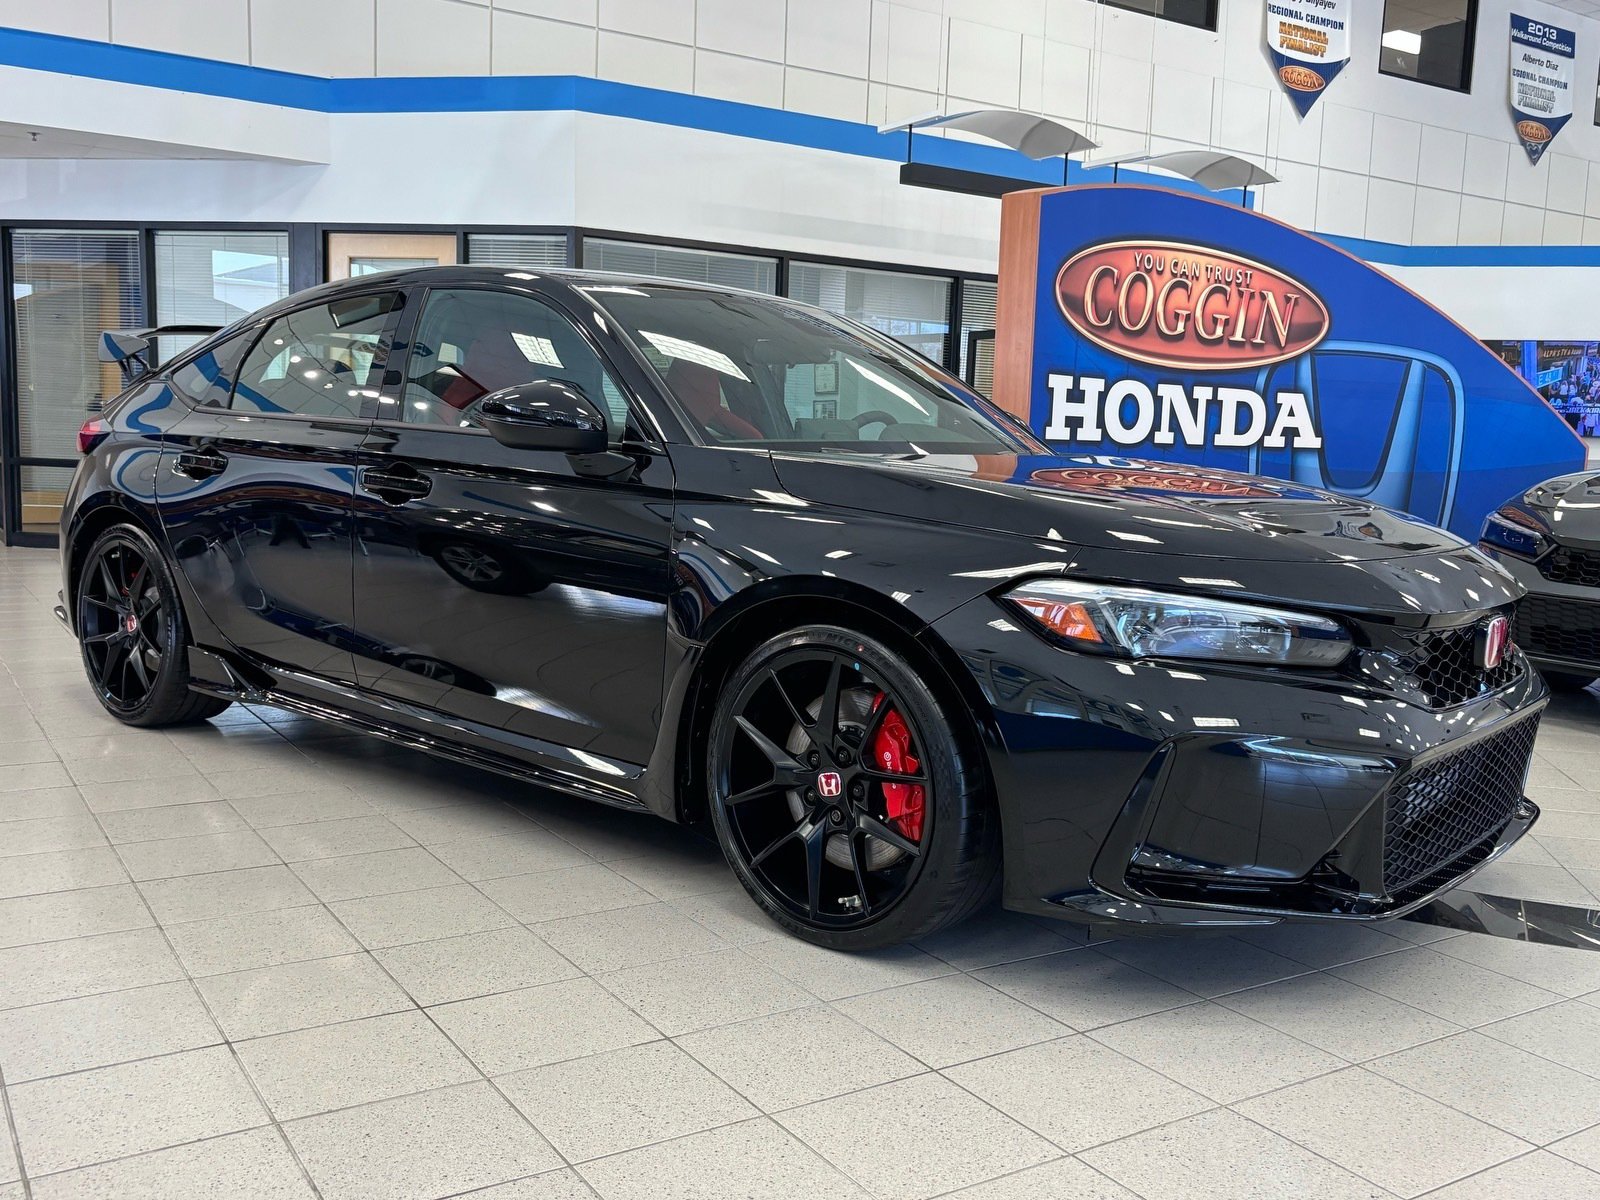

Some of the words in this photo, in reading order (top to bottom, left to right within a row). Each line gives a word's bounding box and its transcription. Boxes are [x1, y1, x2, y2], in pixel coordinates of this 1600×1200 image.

[1267, 3, 1304, 21] REGIONAL
[1305, 13, 1344, 31] CHAMPION
[1279, 21, 1328, 45] NATIONAL
[1511, 28, 1541, 44] Walkaround
[1542, 37, 1572, 53] Competition
[1527, 22, 1557, 40] 2013
[1279, 35, 1327, 58] FINALIST
[1522, 53, 1545, 67] Alberto
[1545, 59, 1559, 71] Diaz
[1282, 70, 1319, 89] COGGIN
[1512, 68, 1537, 82] EGIONAL
[1538, 76, 1568, 90] CHAMPION
[1518, 82, 1555, 102] NATIONAL
[1518, 95, 1554, 113] FINALIST
[1134, 251, 1165, 272] YOU
[1170, 259, 1201, 279] CAN
[1206, 264, 1253, 286] TRUST
[1083, 265, 1301, 348] COGGIN
[1045, 373, 1321, 449] HONDA
